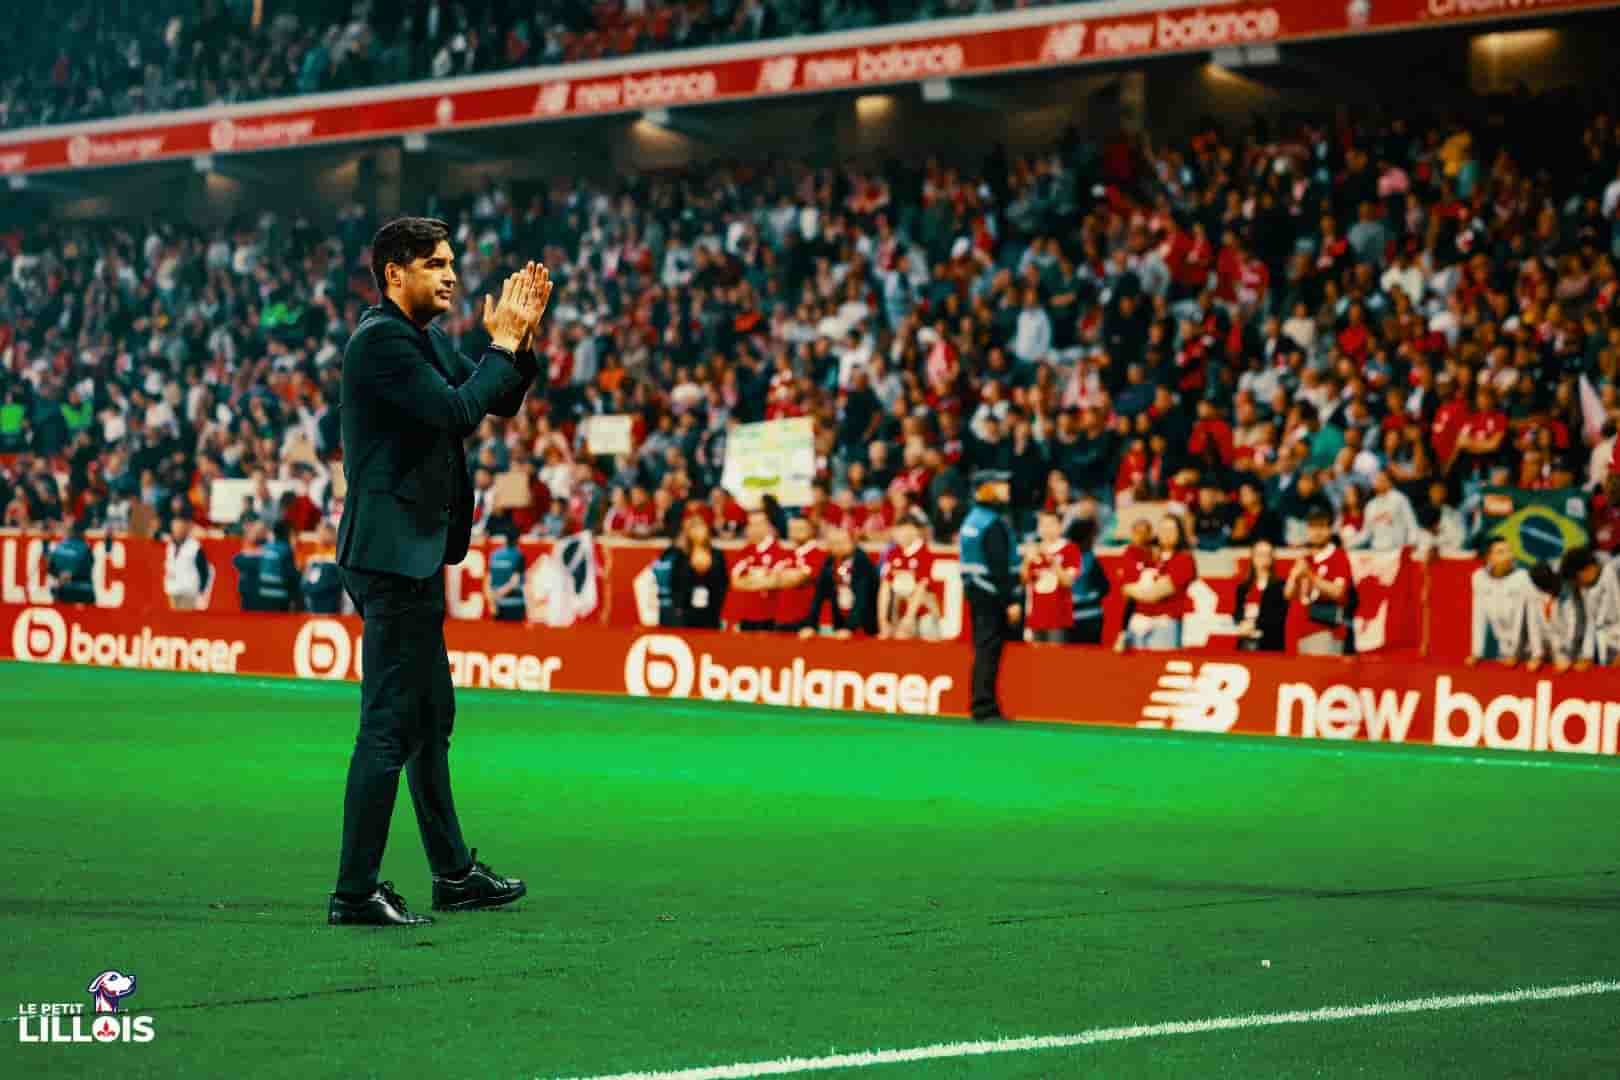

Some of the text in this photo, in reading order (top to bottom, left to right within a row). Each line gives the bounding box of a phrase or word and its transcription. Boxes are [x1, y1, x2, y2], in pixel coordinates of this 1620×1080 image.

[1157, 8, 1280, 47] balance
[857, 43, 963, 79] balance
[3, 538, 126, 608] LOC
[70, 622, 246, 672] boulanger
[700, 653, 953, 714] boulanger
[1276, 682, 1420, 742] new
